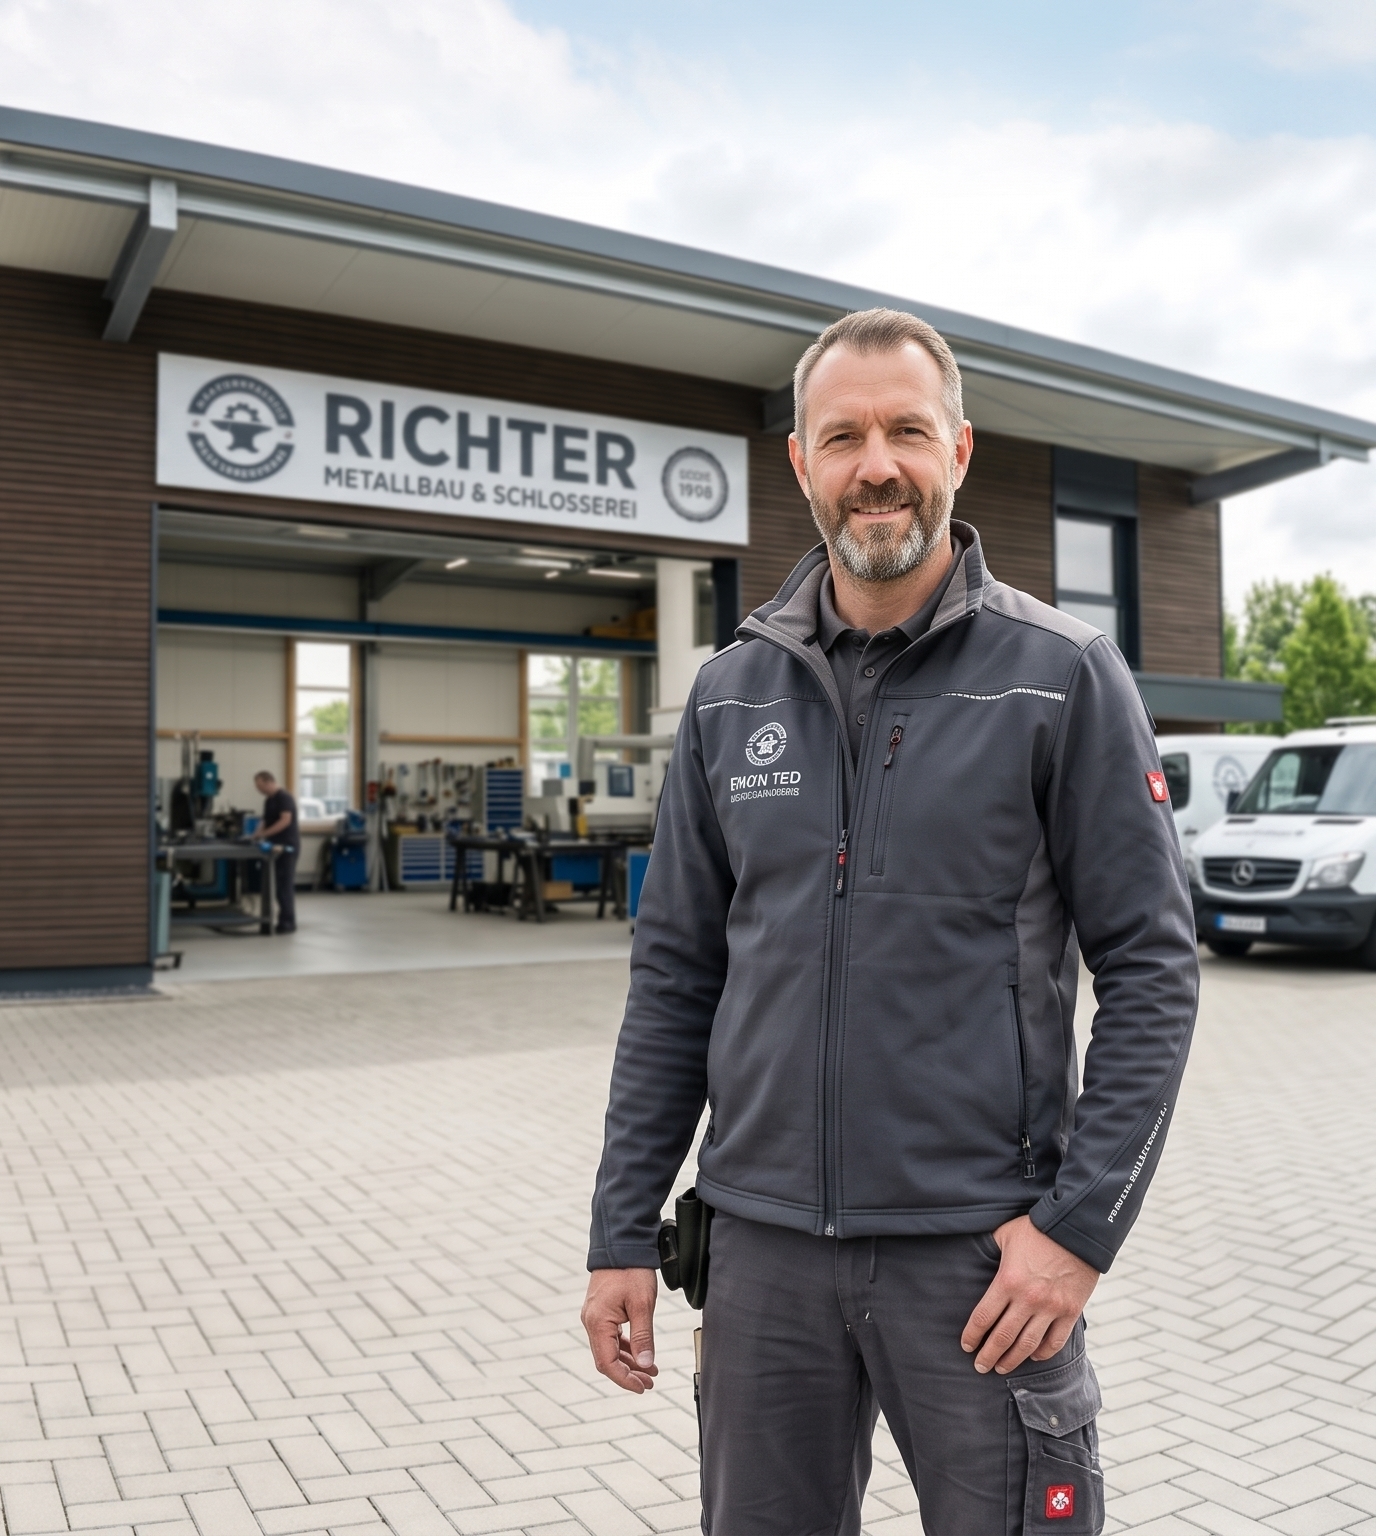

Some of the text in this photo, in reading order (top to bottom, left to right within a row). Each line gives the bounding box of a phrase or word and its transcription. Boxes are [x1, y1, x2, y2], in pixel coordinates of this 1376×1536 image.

[324, 391, 636, 490] RICHTER
[324, 466, 637, 519] METALLBAU & SCHLOSSEREI
[772, 770, 801, 785] TED
